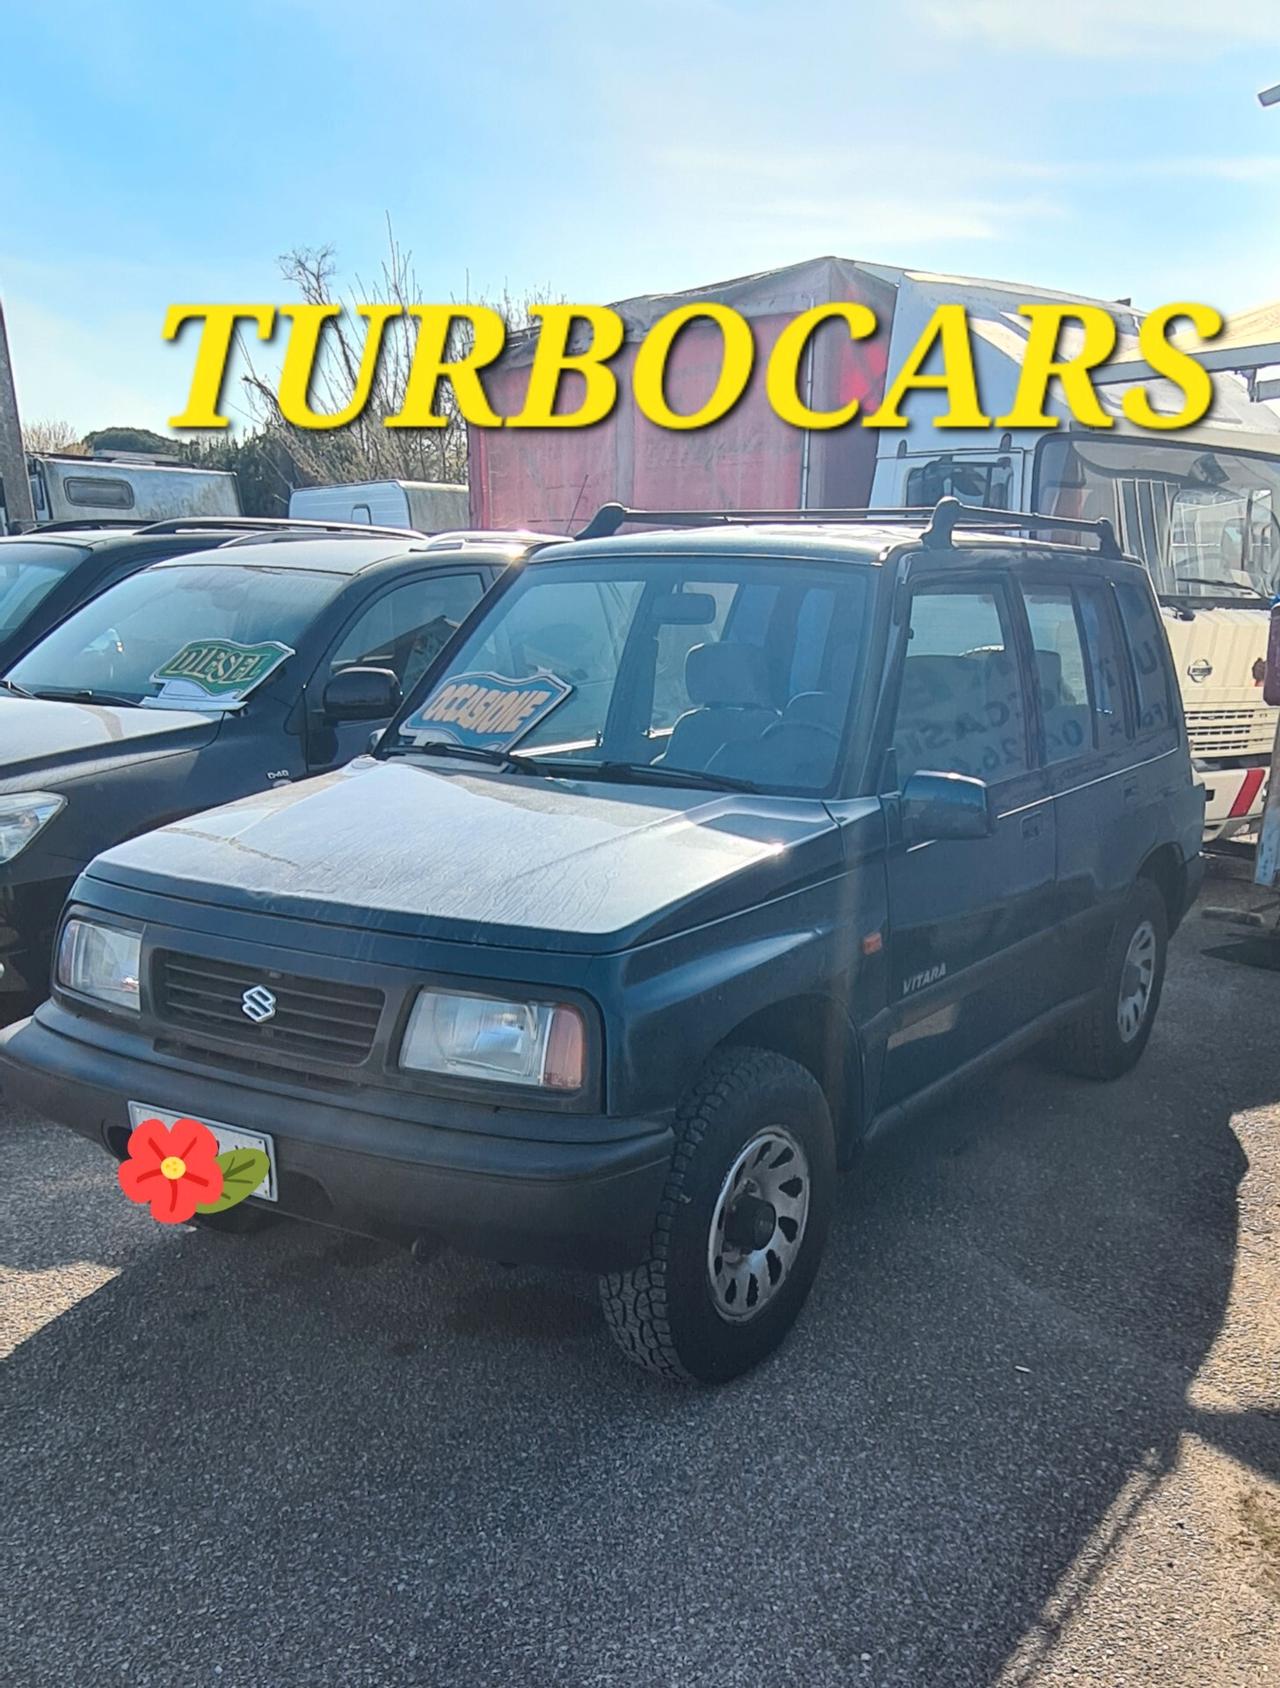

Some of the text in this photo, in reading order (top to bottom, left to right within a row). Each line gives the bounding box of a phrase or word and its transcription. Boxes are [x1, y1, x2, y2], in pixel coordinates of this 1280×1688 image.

[165, 646, 267, 684] DIESEL
[422, 683, 552, 734] OCCASIONE
[903, 962, 947, 995] VITARA
